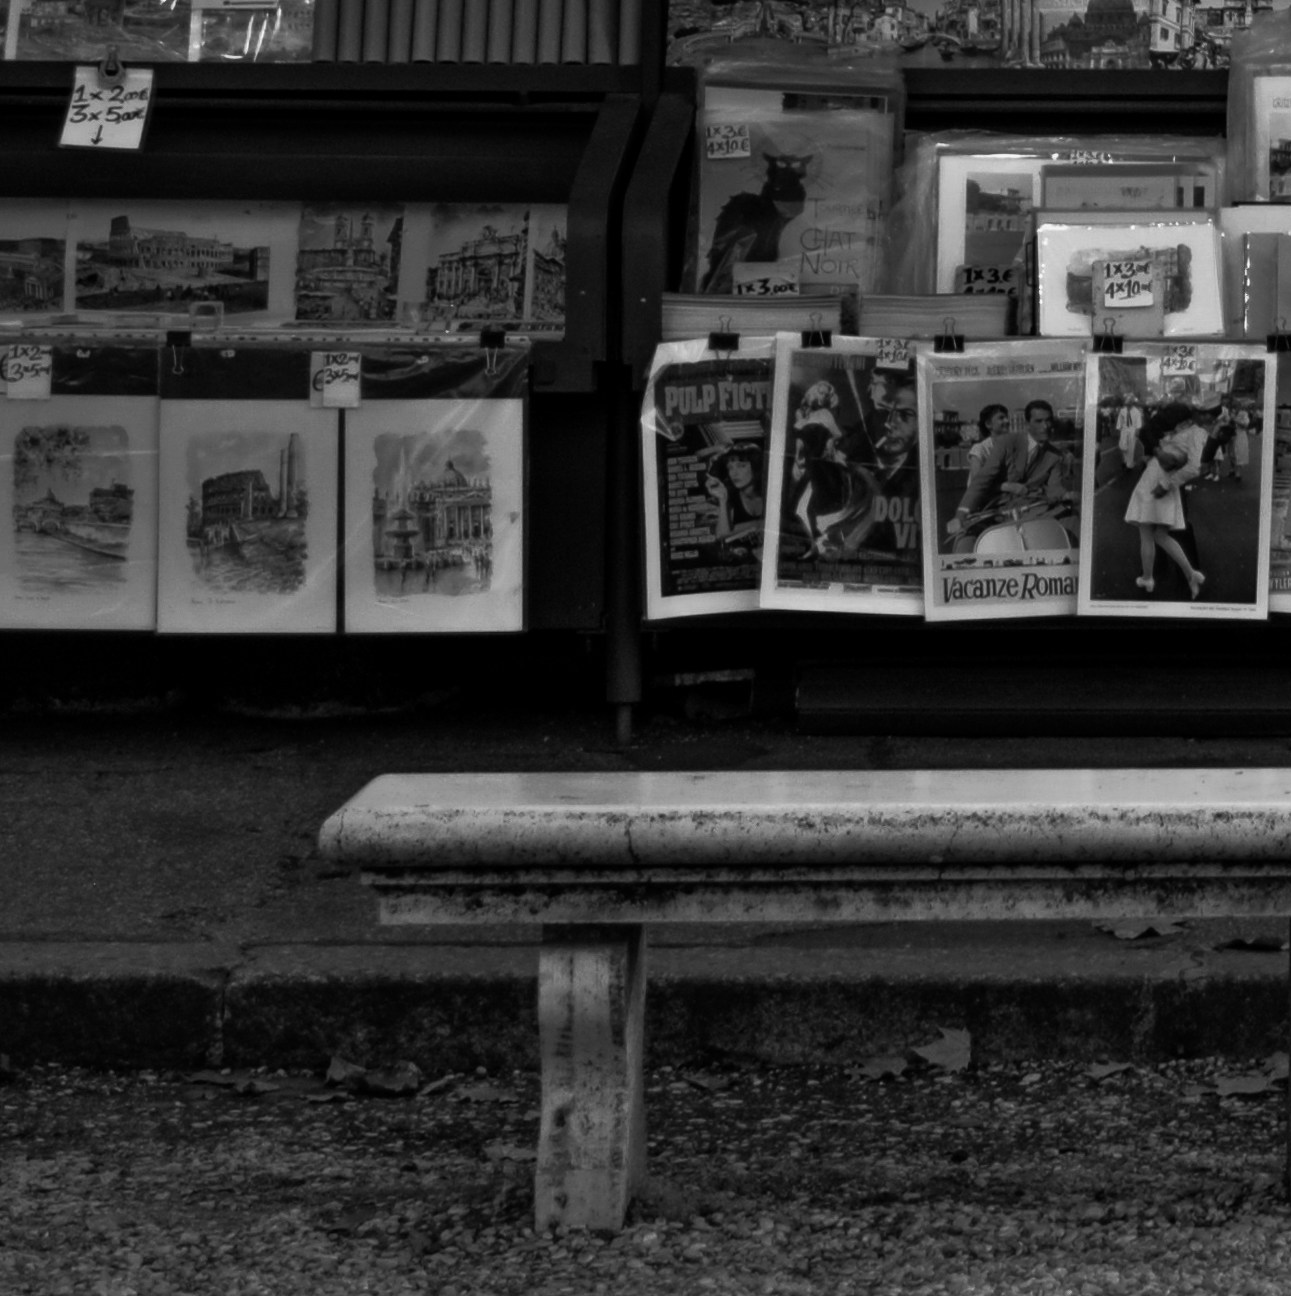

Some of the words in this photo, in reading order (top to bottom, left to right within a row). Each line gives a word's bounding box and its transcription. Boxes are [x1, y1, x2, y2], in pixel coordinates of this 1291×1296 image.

[800, 227, 857, 256] CHAT
[801, 252, 860, 279] NOIR
[665, 384, 716, 417] PULP
[942, 576, 1019, 603] Vacanze
